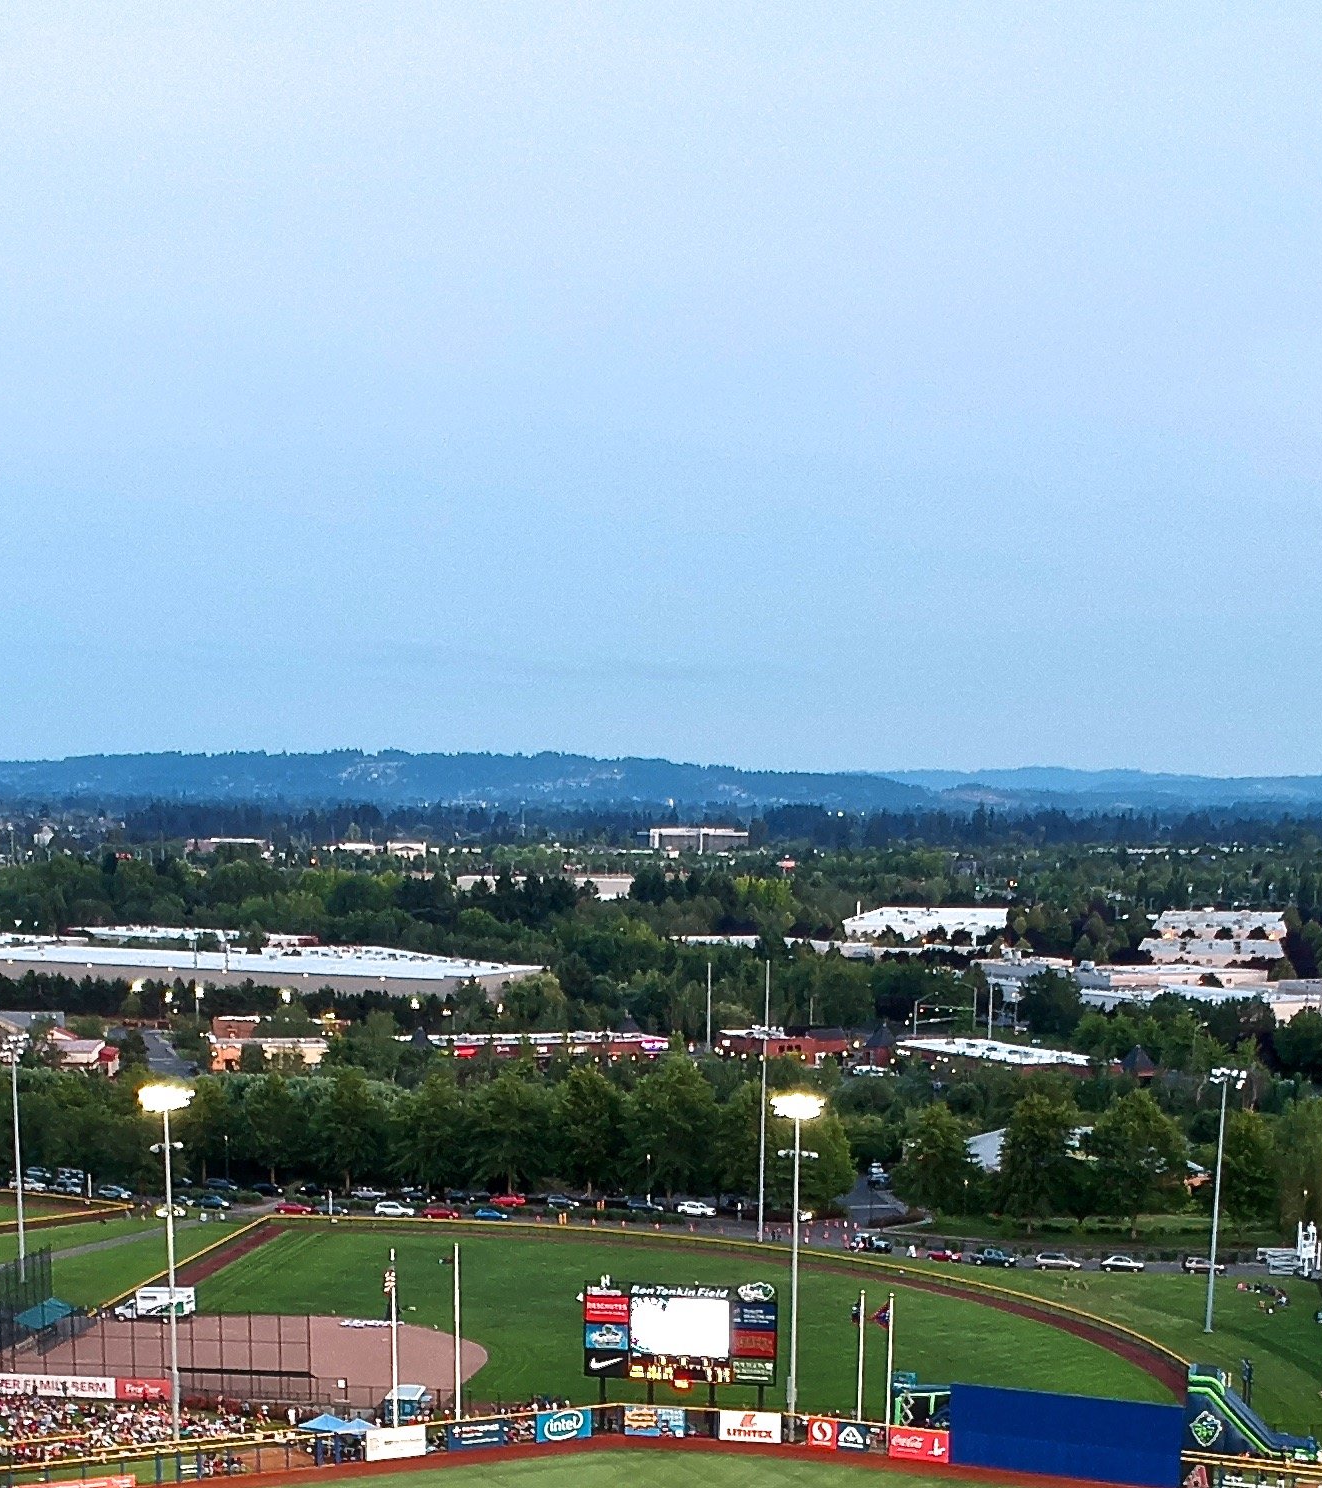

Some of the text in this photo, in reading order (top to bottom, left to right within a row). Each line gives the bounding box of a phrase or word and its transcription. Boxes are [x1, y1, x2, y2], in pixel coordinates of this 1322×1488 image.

[630, 1285, 729, 1298] Ron Tonkin Field
[71, 1381, 107, 1393] BERM
[549, 1415, 578, 1432] intel
